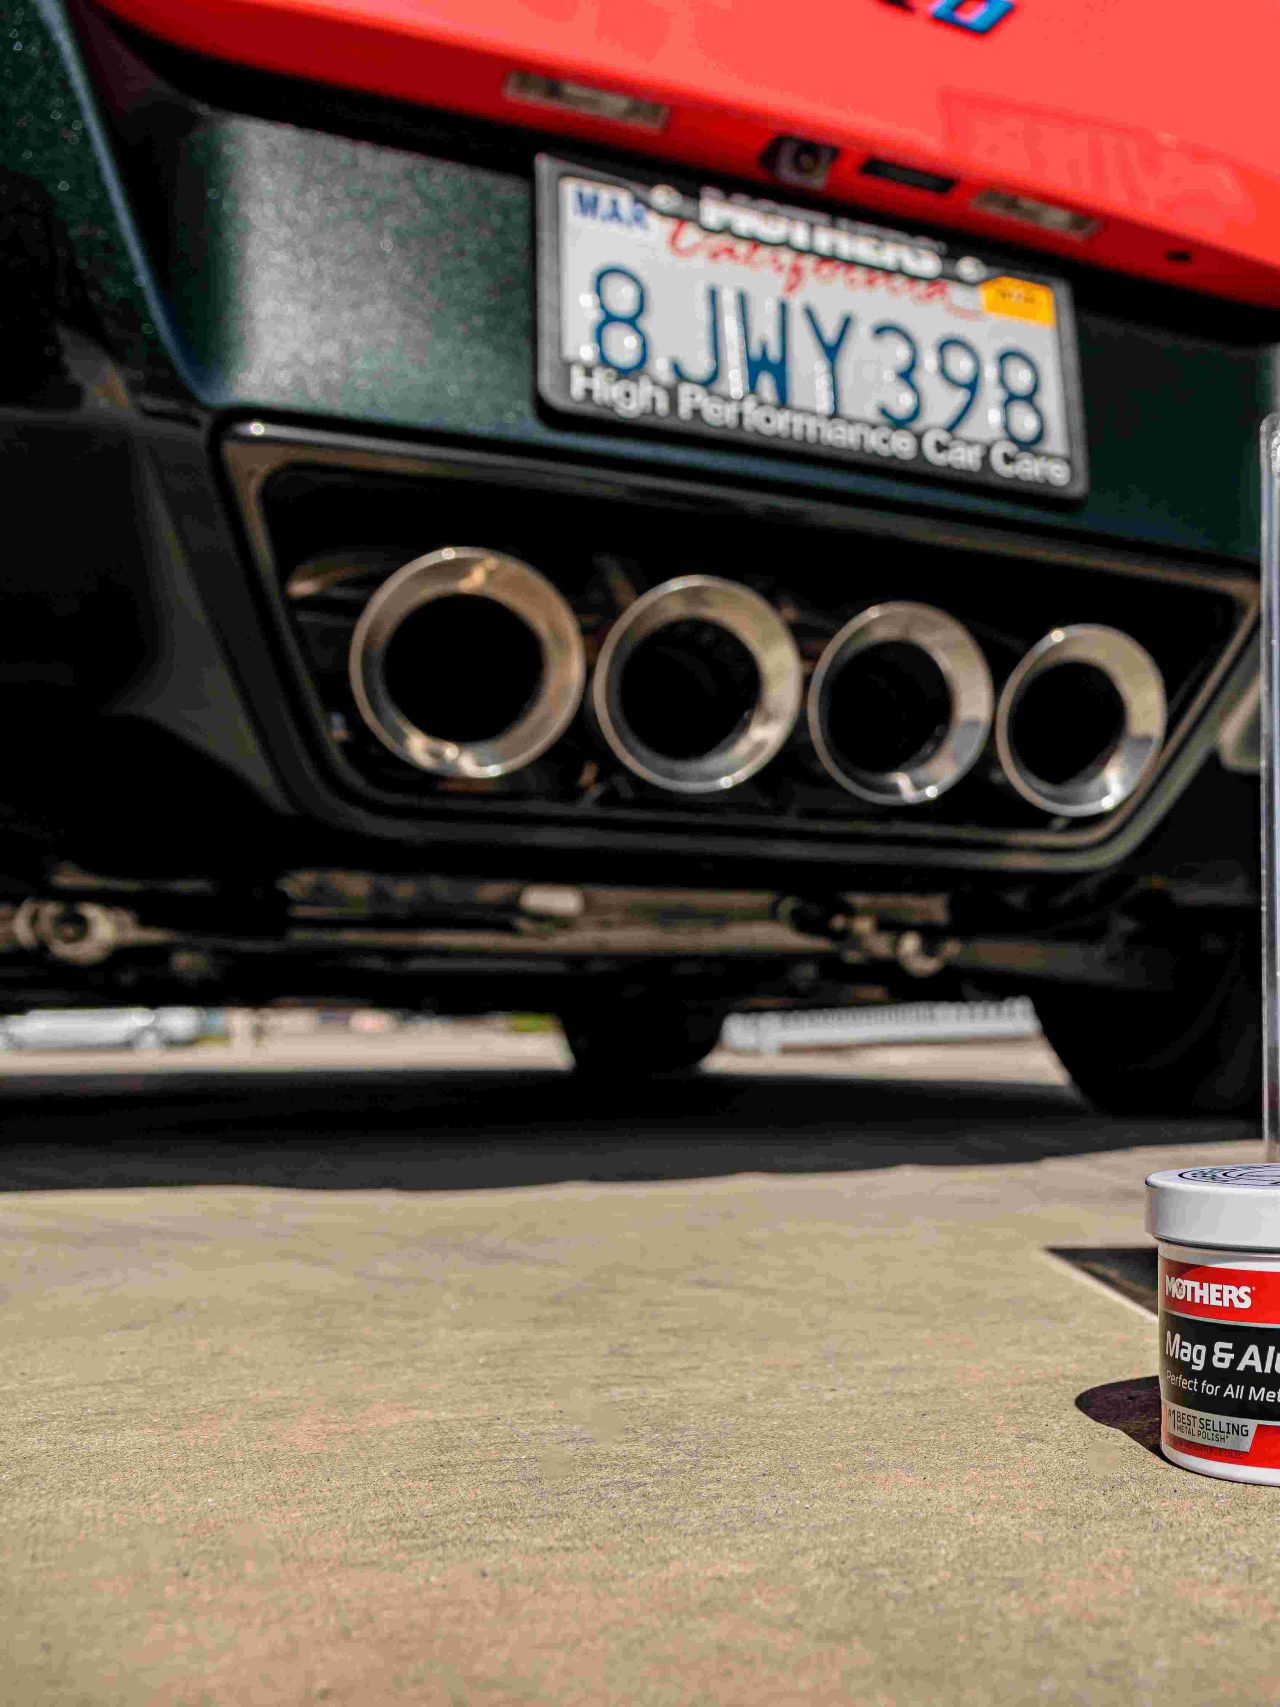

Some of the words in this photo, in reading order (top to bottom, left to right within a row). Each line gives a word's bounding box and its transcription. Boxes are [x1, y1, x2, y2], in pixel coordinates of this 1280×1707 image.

[594, 266, 1044, 446] 8JWY398
[571, 365, 670, 419] High
[677, 381, 918, 461] Performance
[921, 428, 987, 473] Car
[990, 440, 1071, 487] Care
[1165, 1274, 1252, 1309] MOTHERS
[1165, 1330, 1207, 1371] Mag
[1212, 1341, 1235, 1369] &
[1166, 1369, 1198, 1392] Perfect
[1201, 1380, 1220, 1396] for
[1223, 1384, 1245, 1400] All
[1176, 1410, 1197, 1428] BEST
[1198, 1418, 1249, 1437] SELLING
[1176, 1425, 1196, 1437] METAL
